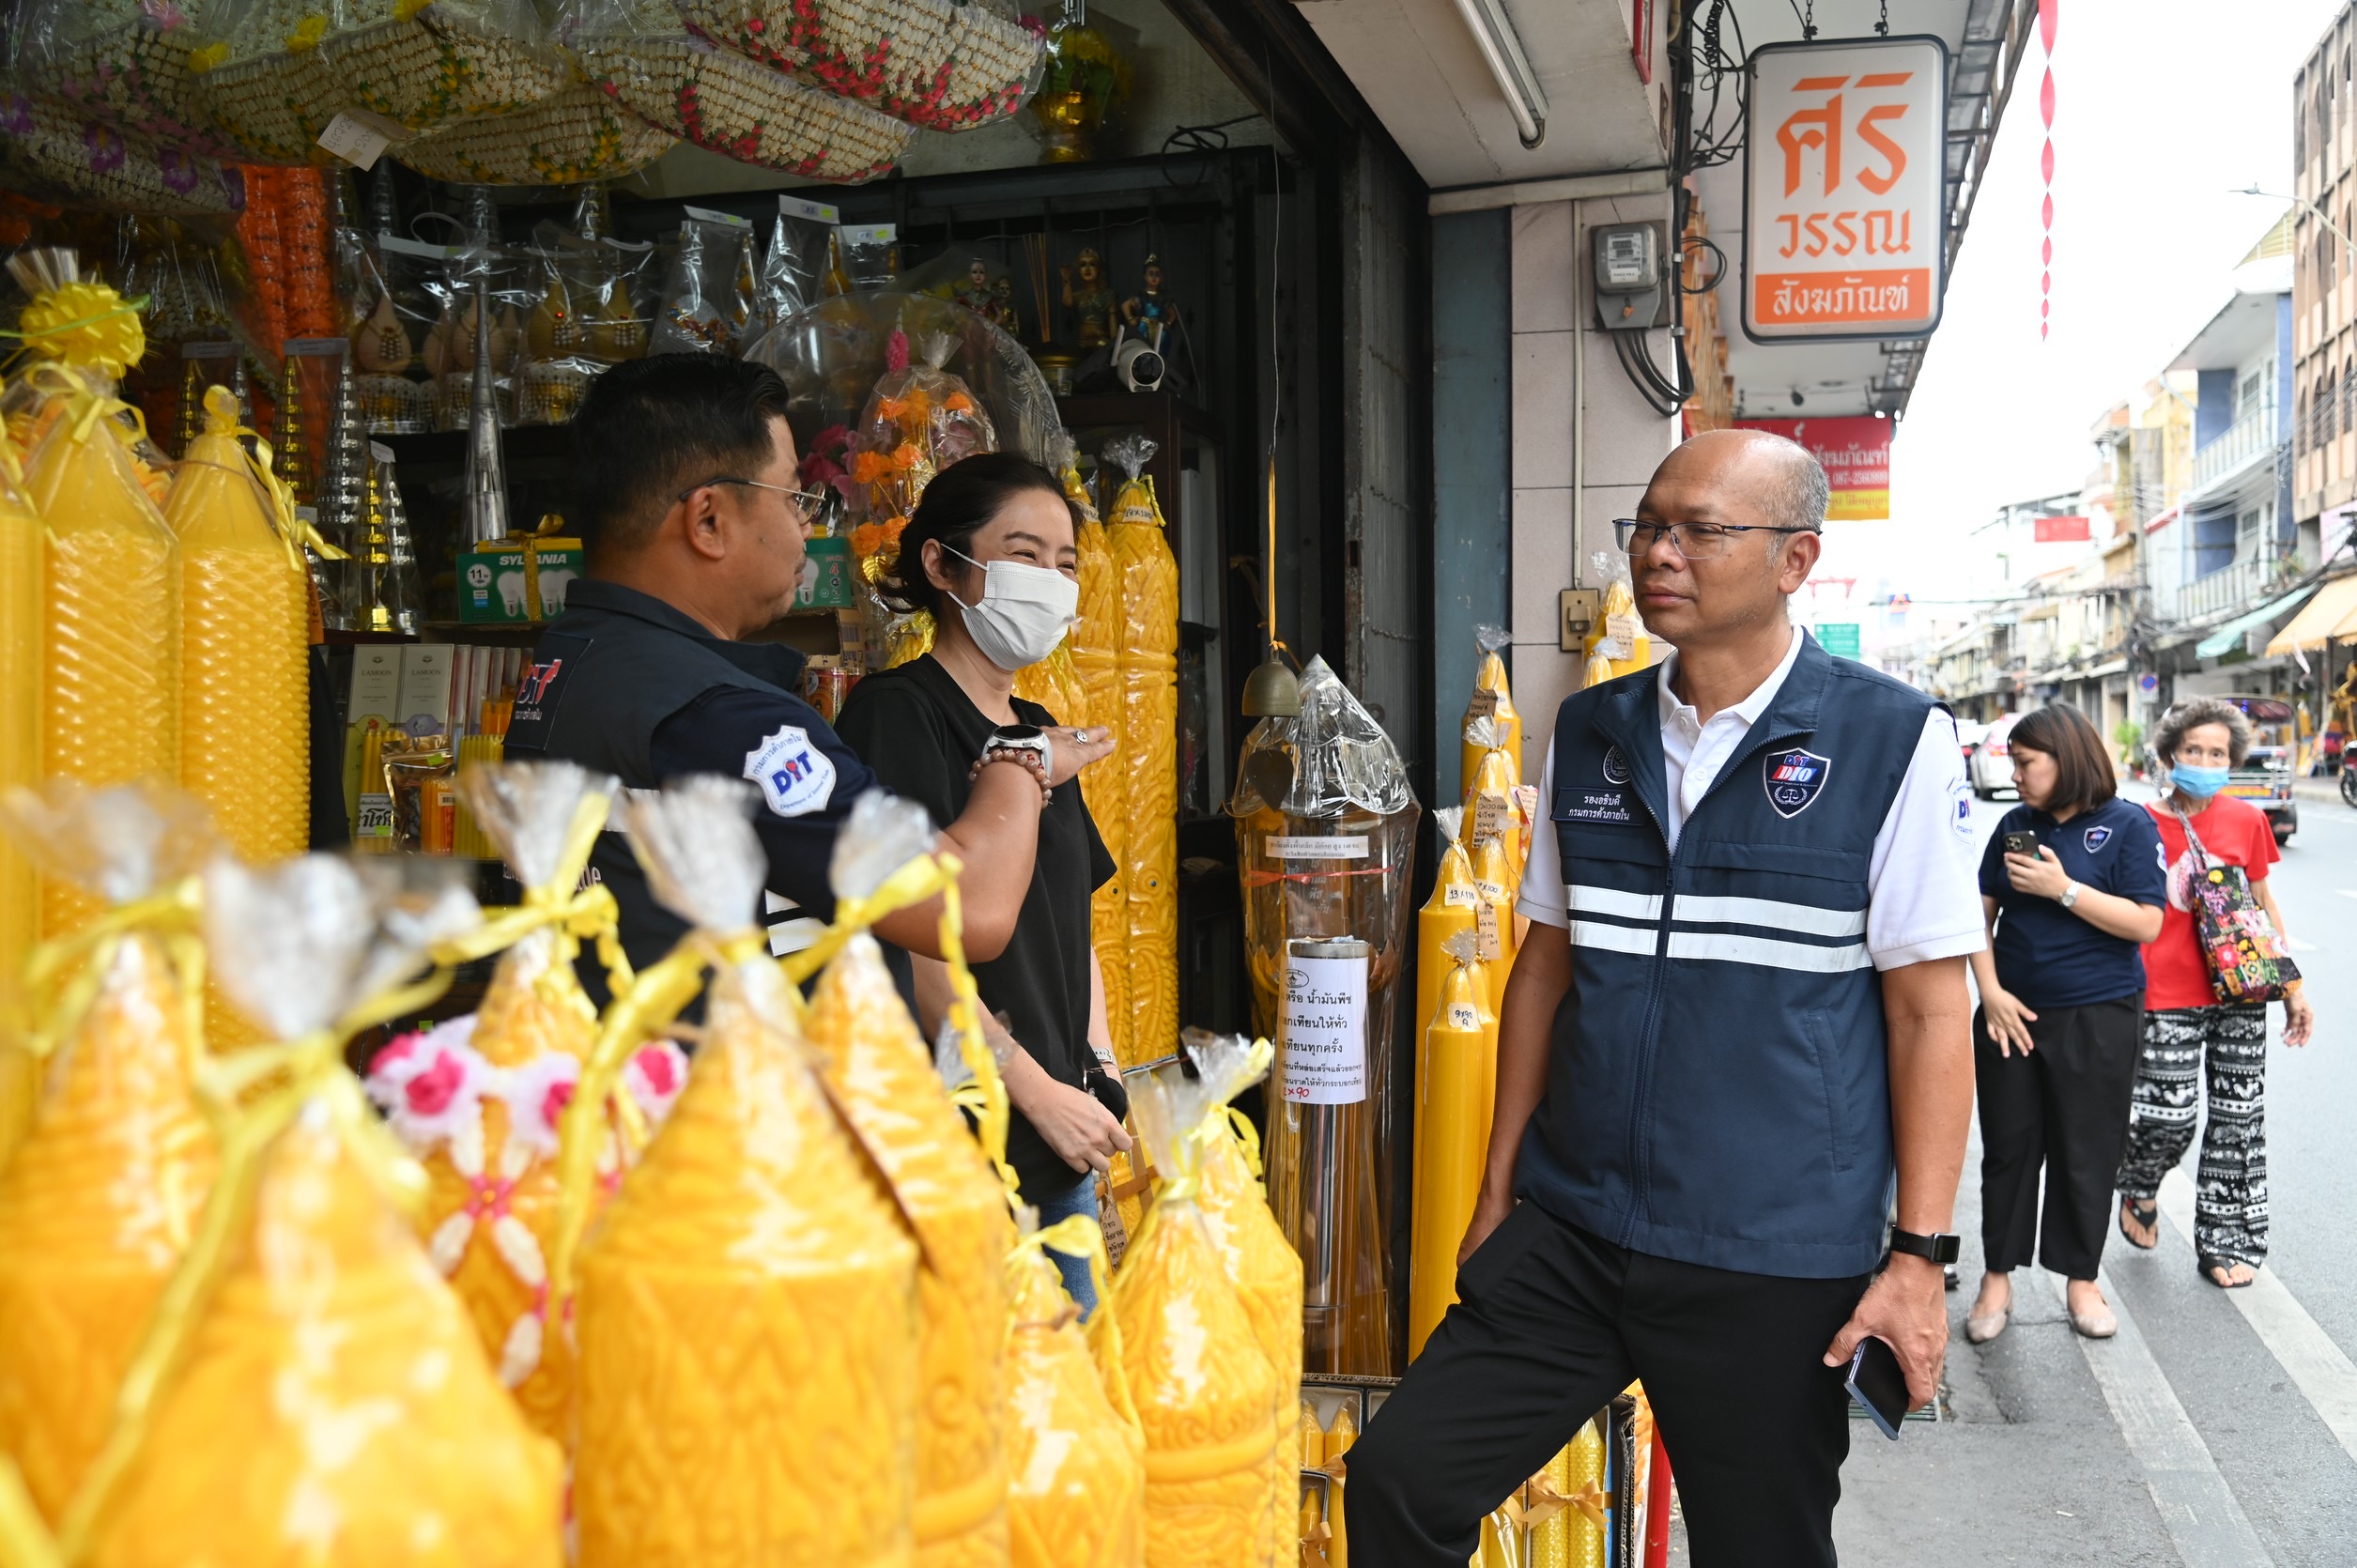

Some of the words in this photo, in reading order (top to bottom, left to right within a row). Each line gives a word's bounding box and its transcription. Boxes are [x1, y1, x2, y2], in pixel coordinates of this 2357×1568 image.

[1776, 71, 1914, 200] ศิริ
[1775, 208, 1912, 259] วรรณ
[1773, 273, 1911, 316] สังฆภัณฑ์
[499, 553, 567, 566] SYLNIA
[470, 569, 483, 578] 11
[830, 563, 839, 576] 4
[753, 733, 803, 776] กรมการค้าภายใน
[769, 750, 813, 796] DIT
[1777, 765, 1813, 782] DIO
[1584, 793, 1622, 807] รองอธิบดี
[1568, 807, 1630, 821] กรมการค้าภายใน
[1307, 989, 1352, 1005] น้ำมันพืช
